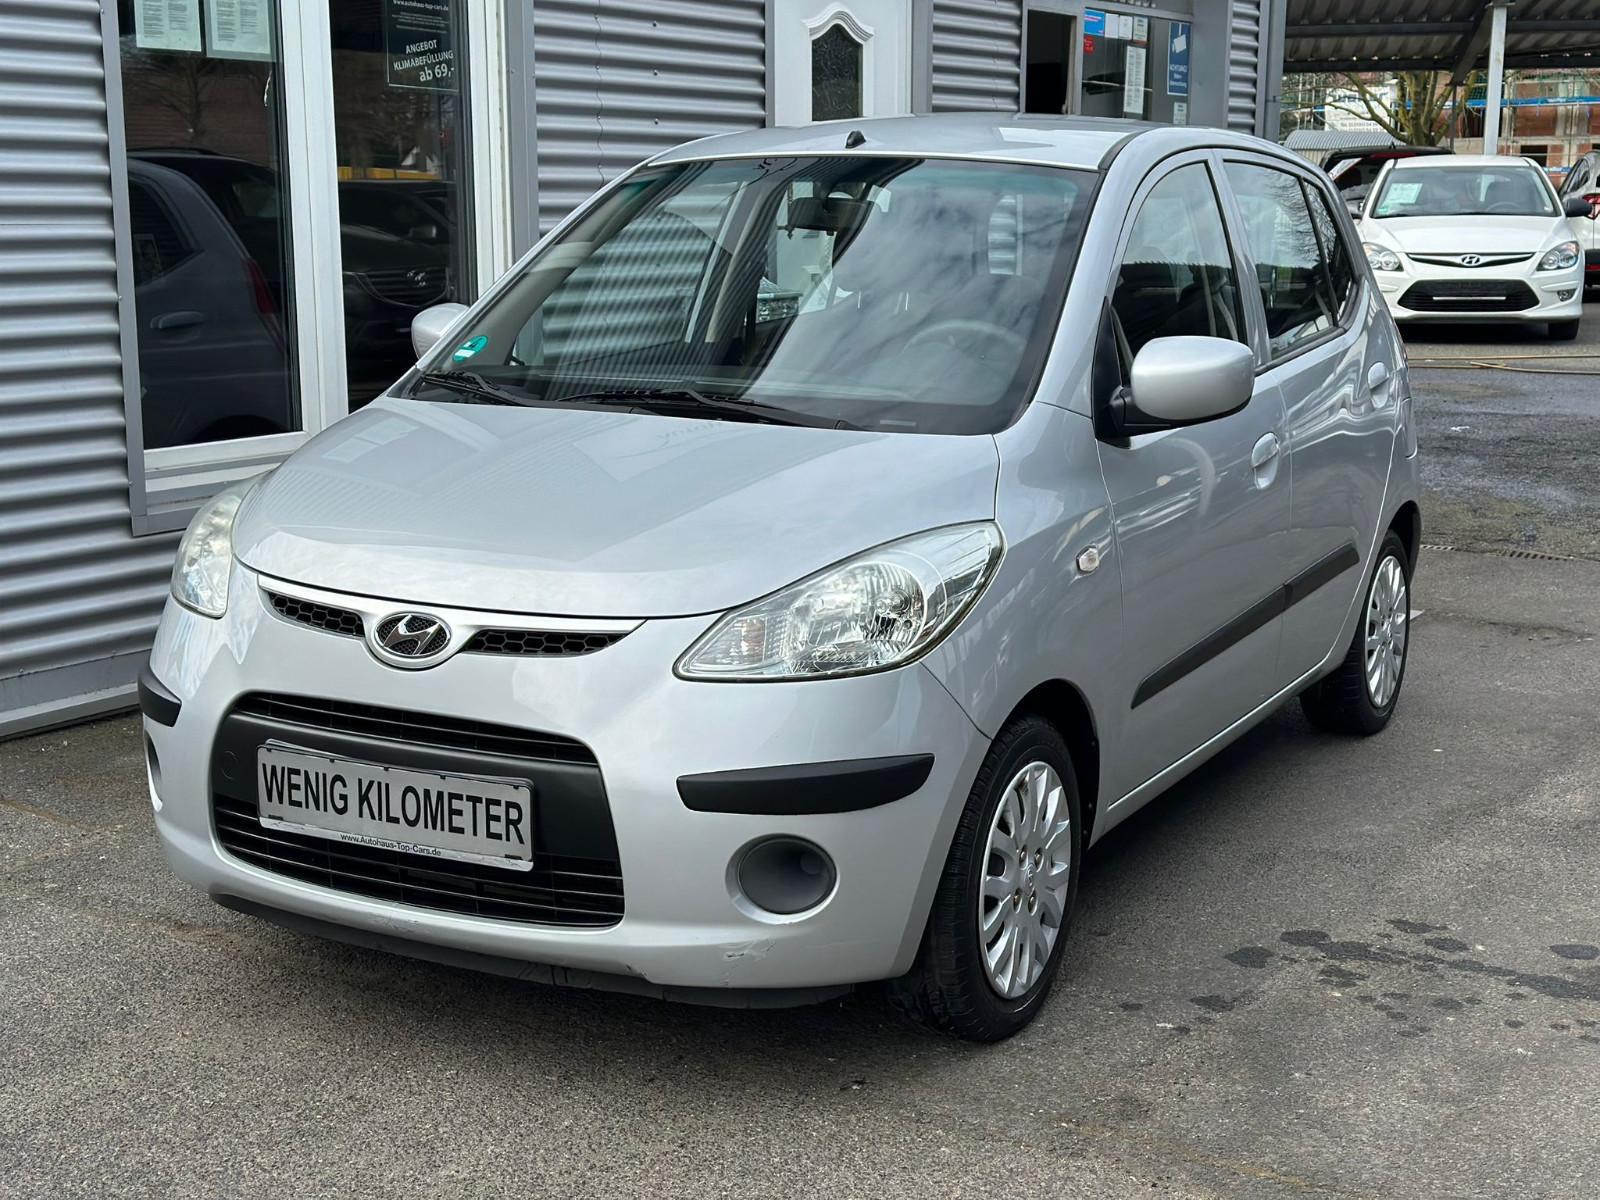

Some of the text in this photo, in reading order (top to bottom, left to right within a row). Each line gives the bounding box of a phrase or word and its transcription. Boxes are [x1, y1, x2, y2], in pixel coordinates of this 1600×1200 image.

[405, 39, 437, 54] ANGEBOT
[393, 50, 454, 71] KLIMABEFÜLLUNG
[419, 63, 455, 82] ab 69,-
[262, 762, 525, 845] WENIG KILOMETER
[340, 833, 442, 857] www.Autohaus-Top-Cars.de
